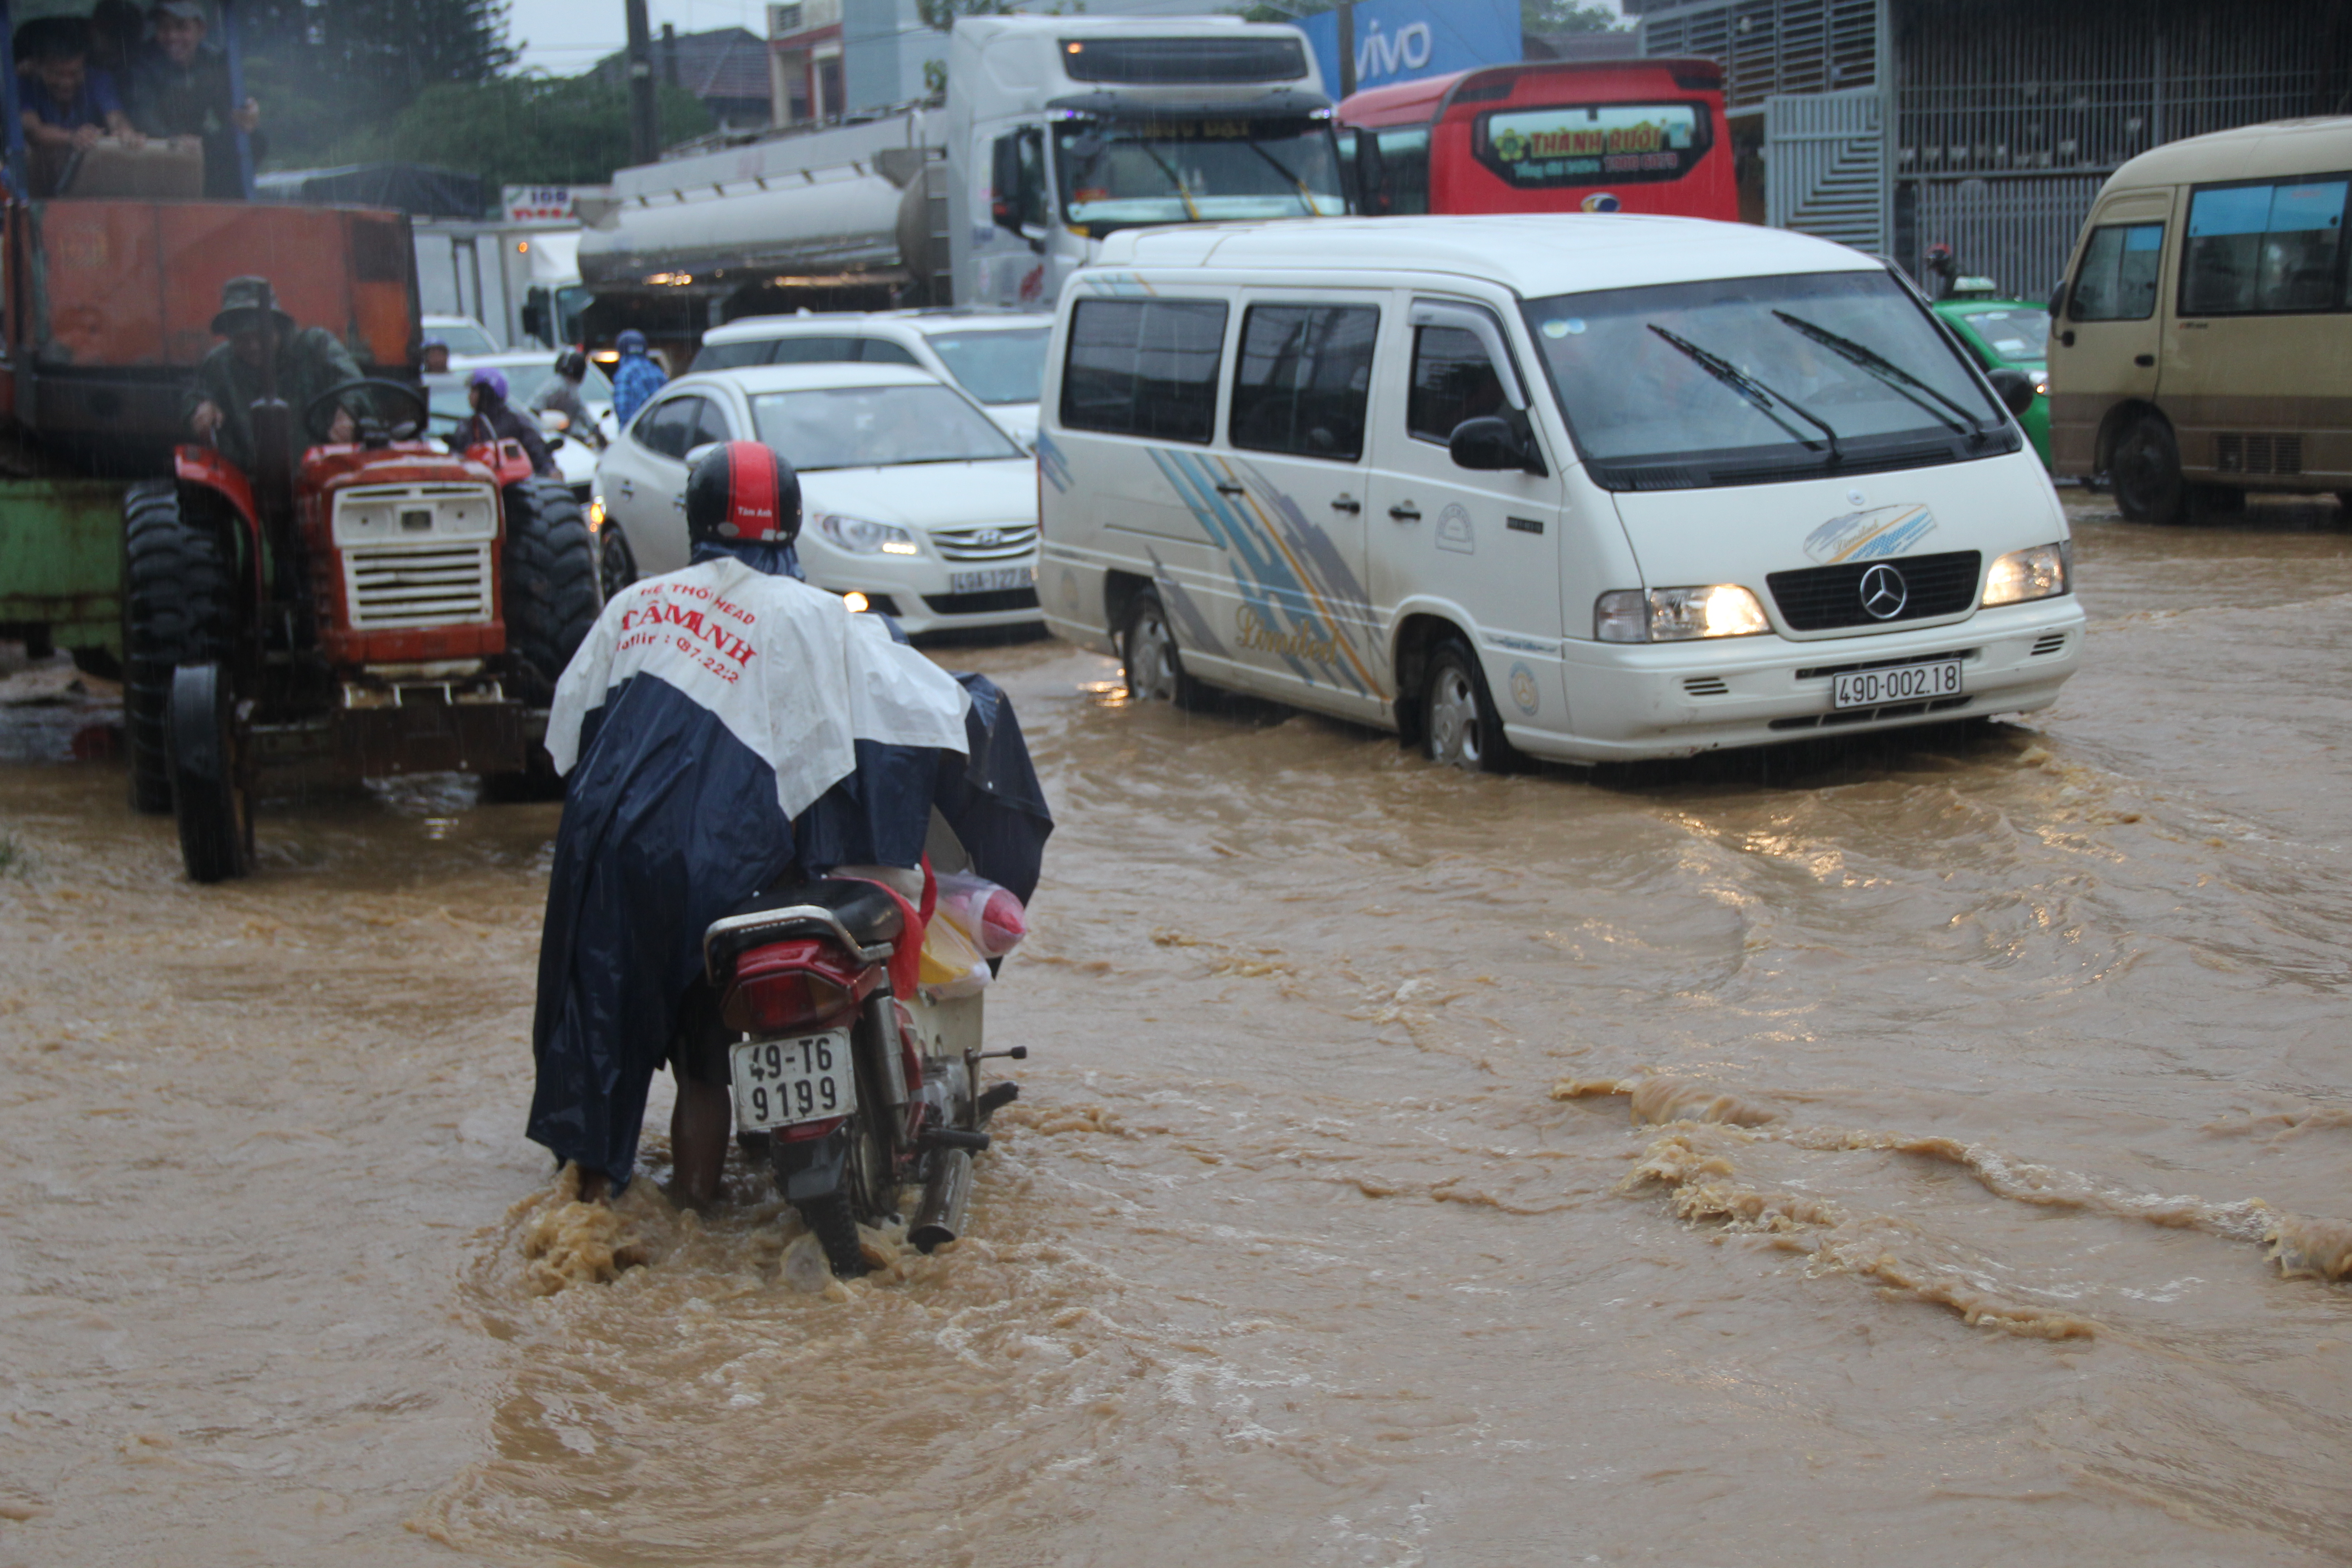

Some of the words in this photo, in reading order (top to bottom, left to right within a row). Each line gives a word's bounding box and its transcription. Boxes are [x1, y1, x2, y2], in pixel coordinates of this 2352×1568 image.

[714, 597, 756, 625] HEAD
[1235, 604, 1340, 666] Limited
[1838, 665, 1956, 704] 49D-002.18
[749, 1037, 833, 1082] 49-T6
[752, 1076, 837, 1122] 9199
